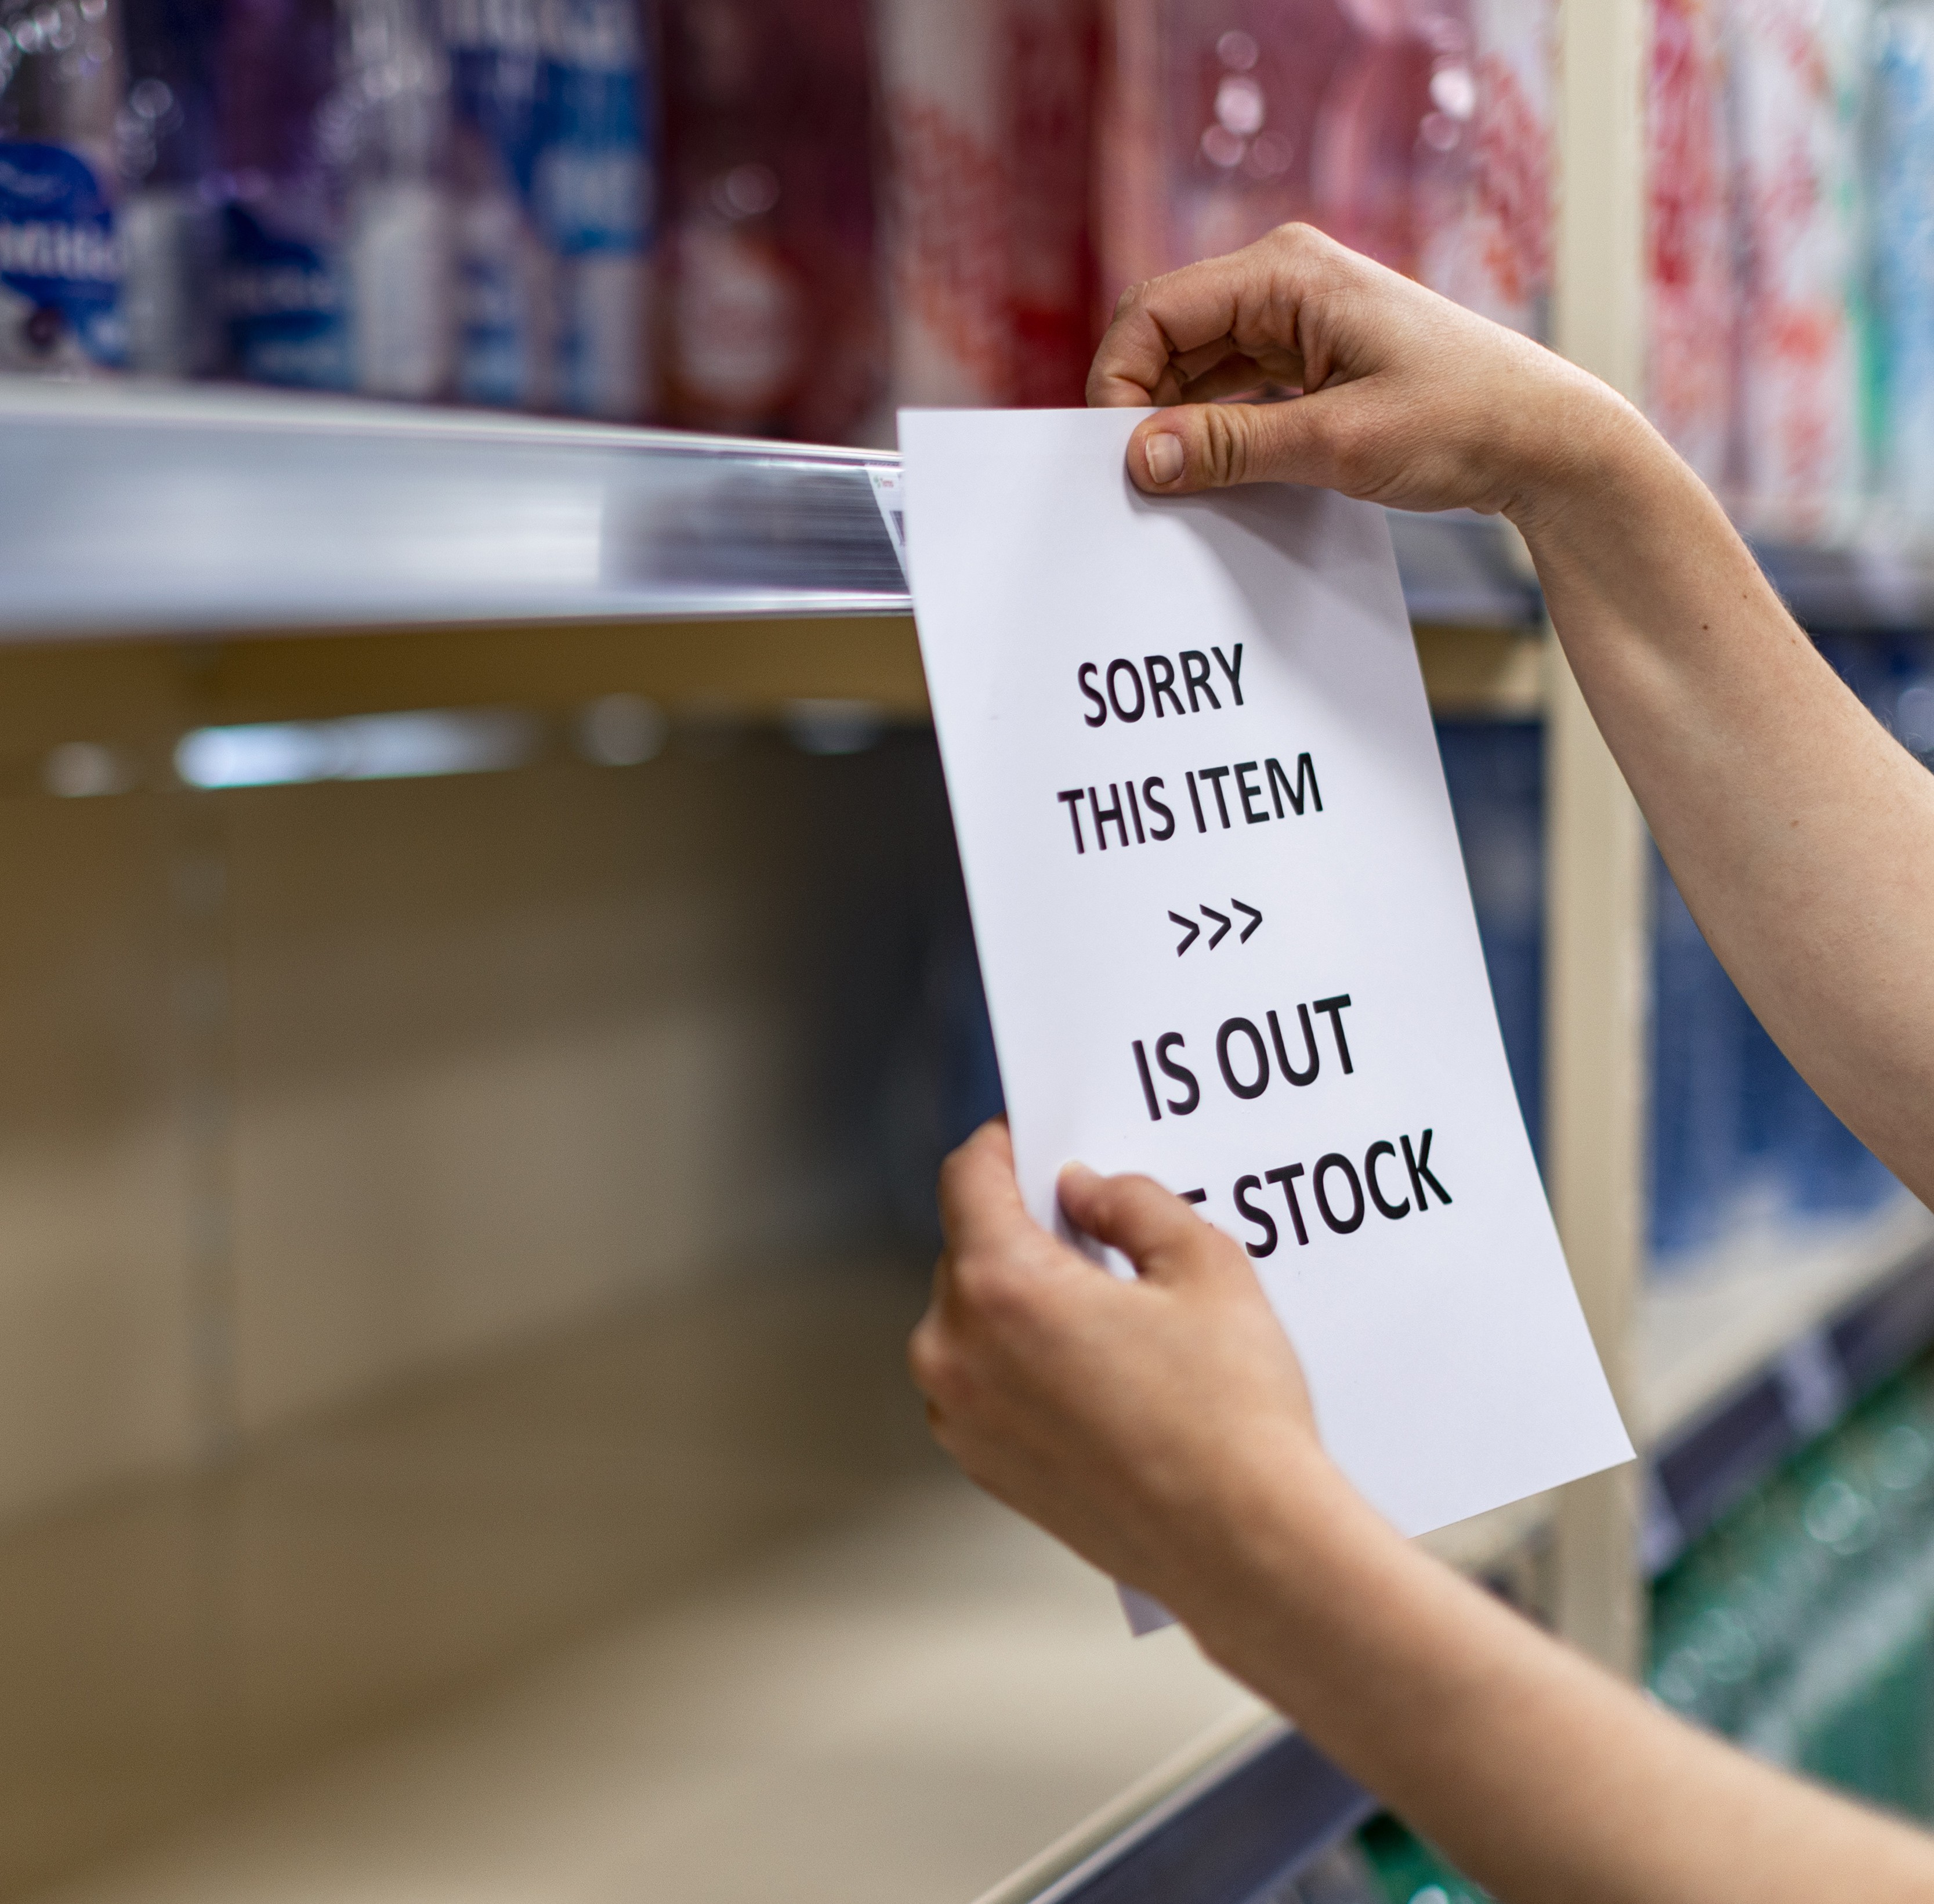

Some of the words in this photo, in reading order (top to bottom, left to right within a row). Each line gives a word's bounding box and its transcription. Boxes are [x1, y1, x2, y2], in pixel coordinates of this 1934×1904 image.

[1078, 643, 1244, 727] SORRY
[1057, 776, 1176, 855] THIS
[1185, 752, 1324, 834] ITEM
[1132, 1031, 1201, 1121] IS
[1216, 993, 1354, 1099] OUT
[1233, 1128, 1453, 1258] STOCK
